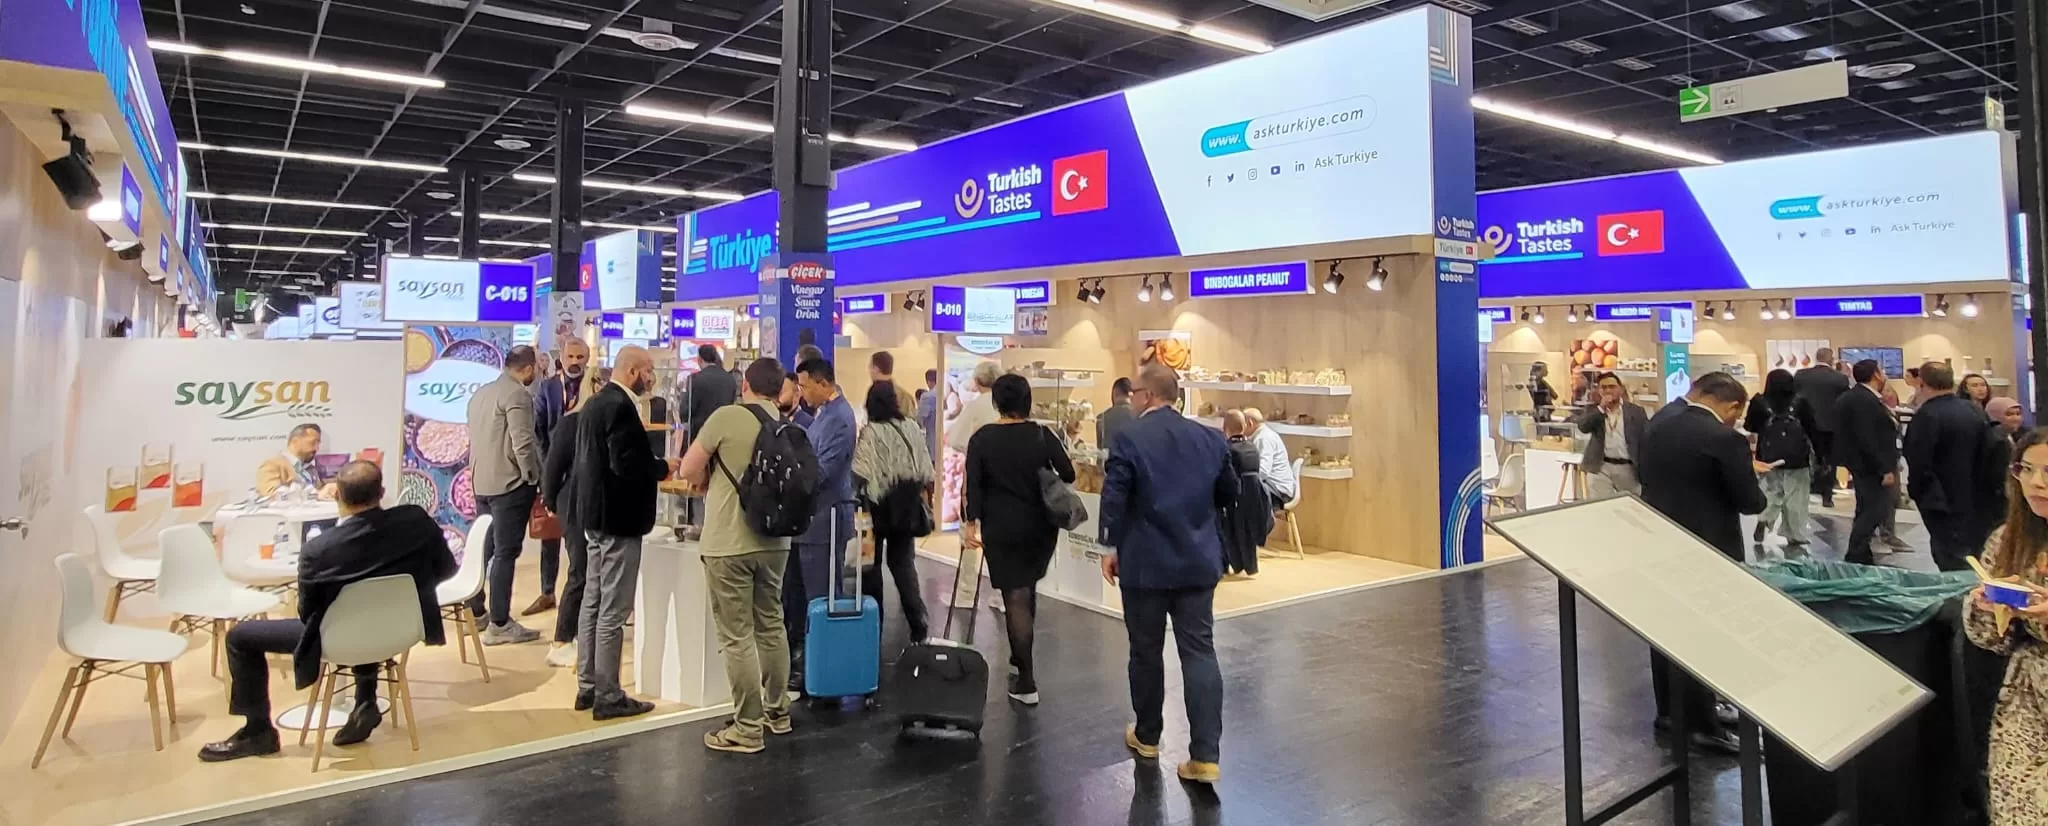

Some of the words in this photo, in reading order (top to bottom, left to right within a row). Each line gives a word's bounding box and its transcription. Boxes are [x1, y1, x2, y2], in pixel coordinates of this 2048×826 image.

[1208, 134, 1241, 149] www.
[1253, 108, 1364, 140] askturkiye.com
[1314, 157, 1334, 169] Ask
[1336, 150, 1379, 165] Turkiye
[987, 164, 1042, 192] Turkish
[987, 191, 1032, 215] Tastes
[1826, 193, 1940, 210] askturkiye.com
[1517, 218, 1584, 237] Turkish
[710, 228, 772, 273] Türkiye
[1517, 238, 1573, 254] Tastes
[1256, 271, 1290, 287] PEANUT
[397, 279, 464, 300] saysan
[486, 285, 528, 302] C-015
[790, 284, 825, 298] Vinegar
[794, 297, 821, 308] Sauce
[936, 303, 962, 316] B-010
[795, 309, 820, 320] Drink
[174, 380, 332, 418] saysan
[418, 381, 482, 403] saysa
